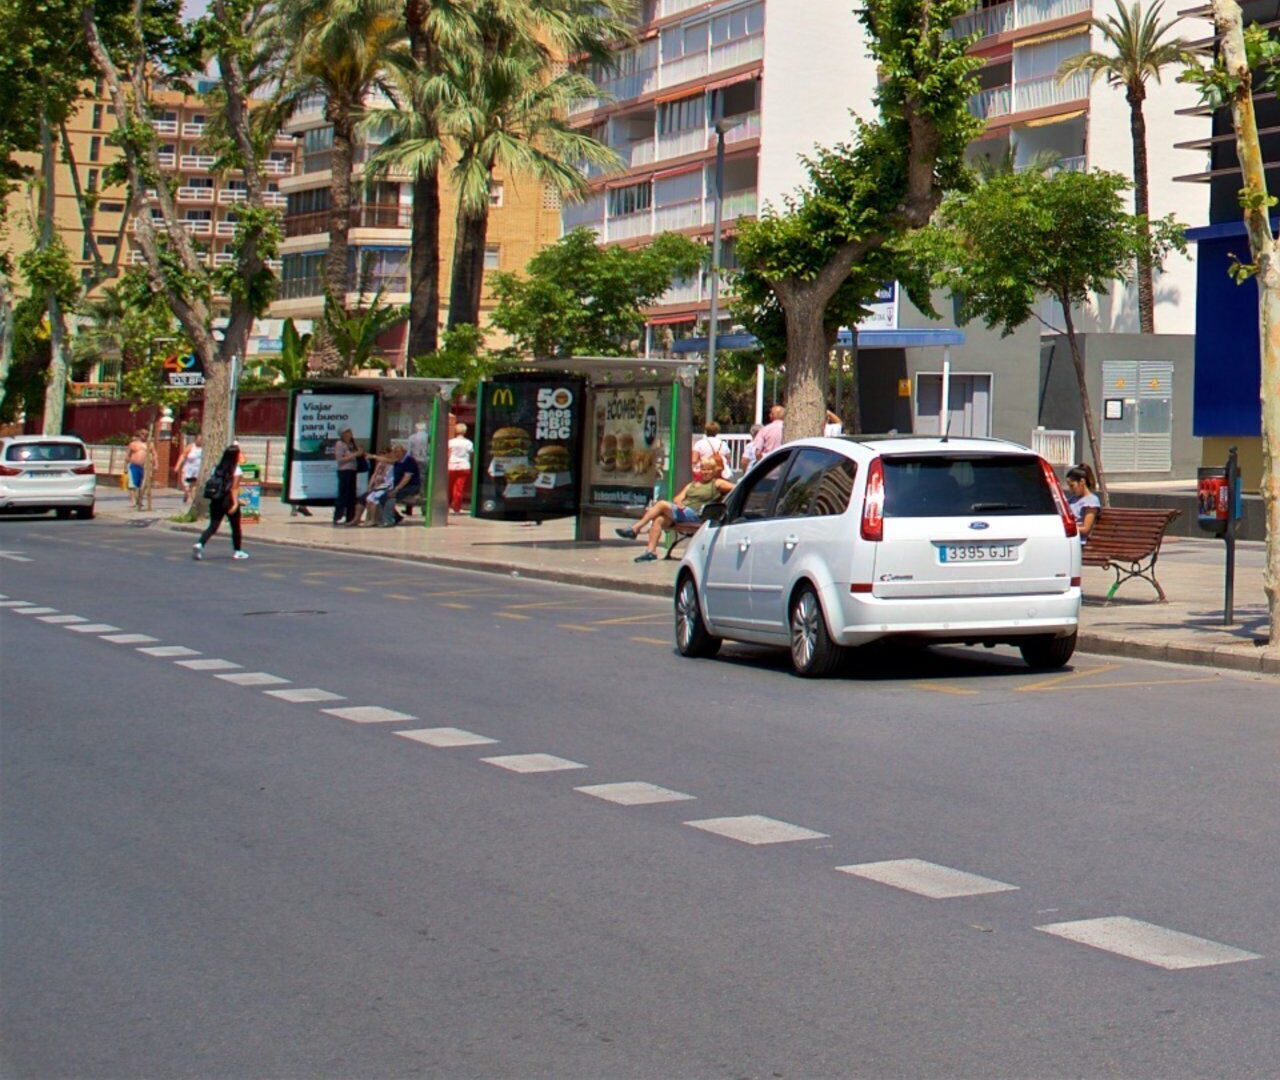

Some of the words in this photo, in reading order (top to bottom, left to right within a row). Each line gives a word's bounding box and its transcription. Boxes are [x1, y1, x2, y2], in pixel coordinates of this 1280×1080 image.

[536, 388, 573, 409] 50
[303, 402, 332, 412] Viajar
[316, 413, 349, 421] bueno
[301, 423, 325, 432] para
[327, 422, 336, 431] la
[949, 547, 985, 560] 3395
[989, 545, 1014, 559] GJF
